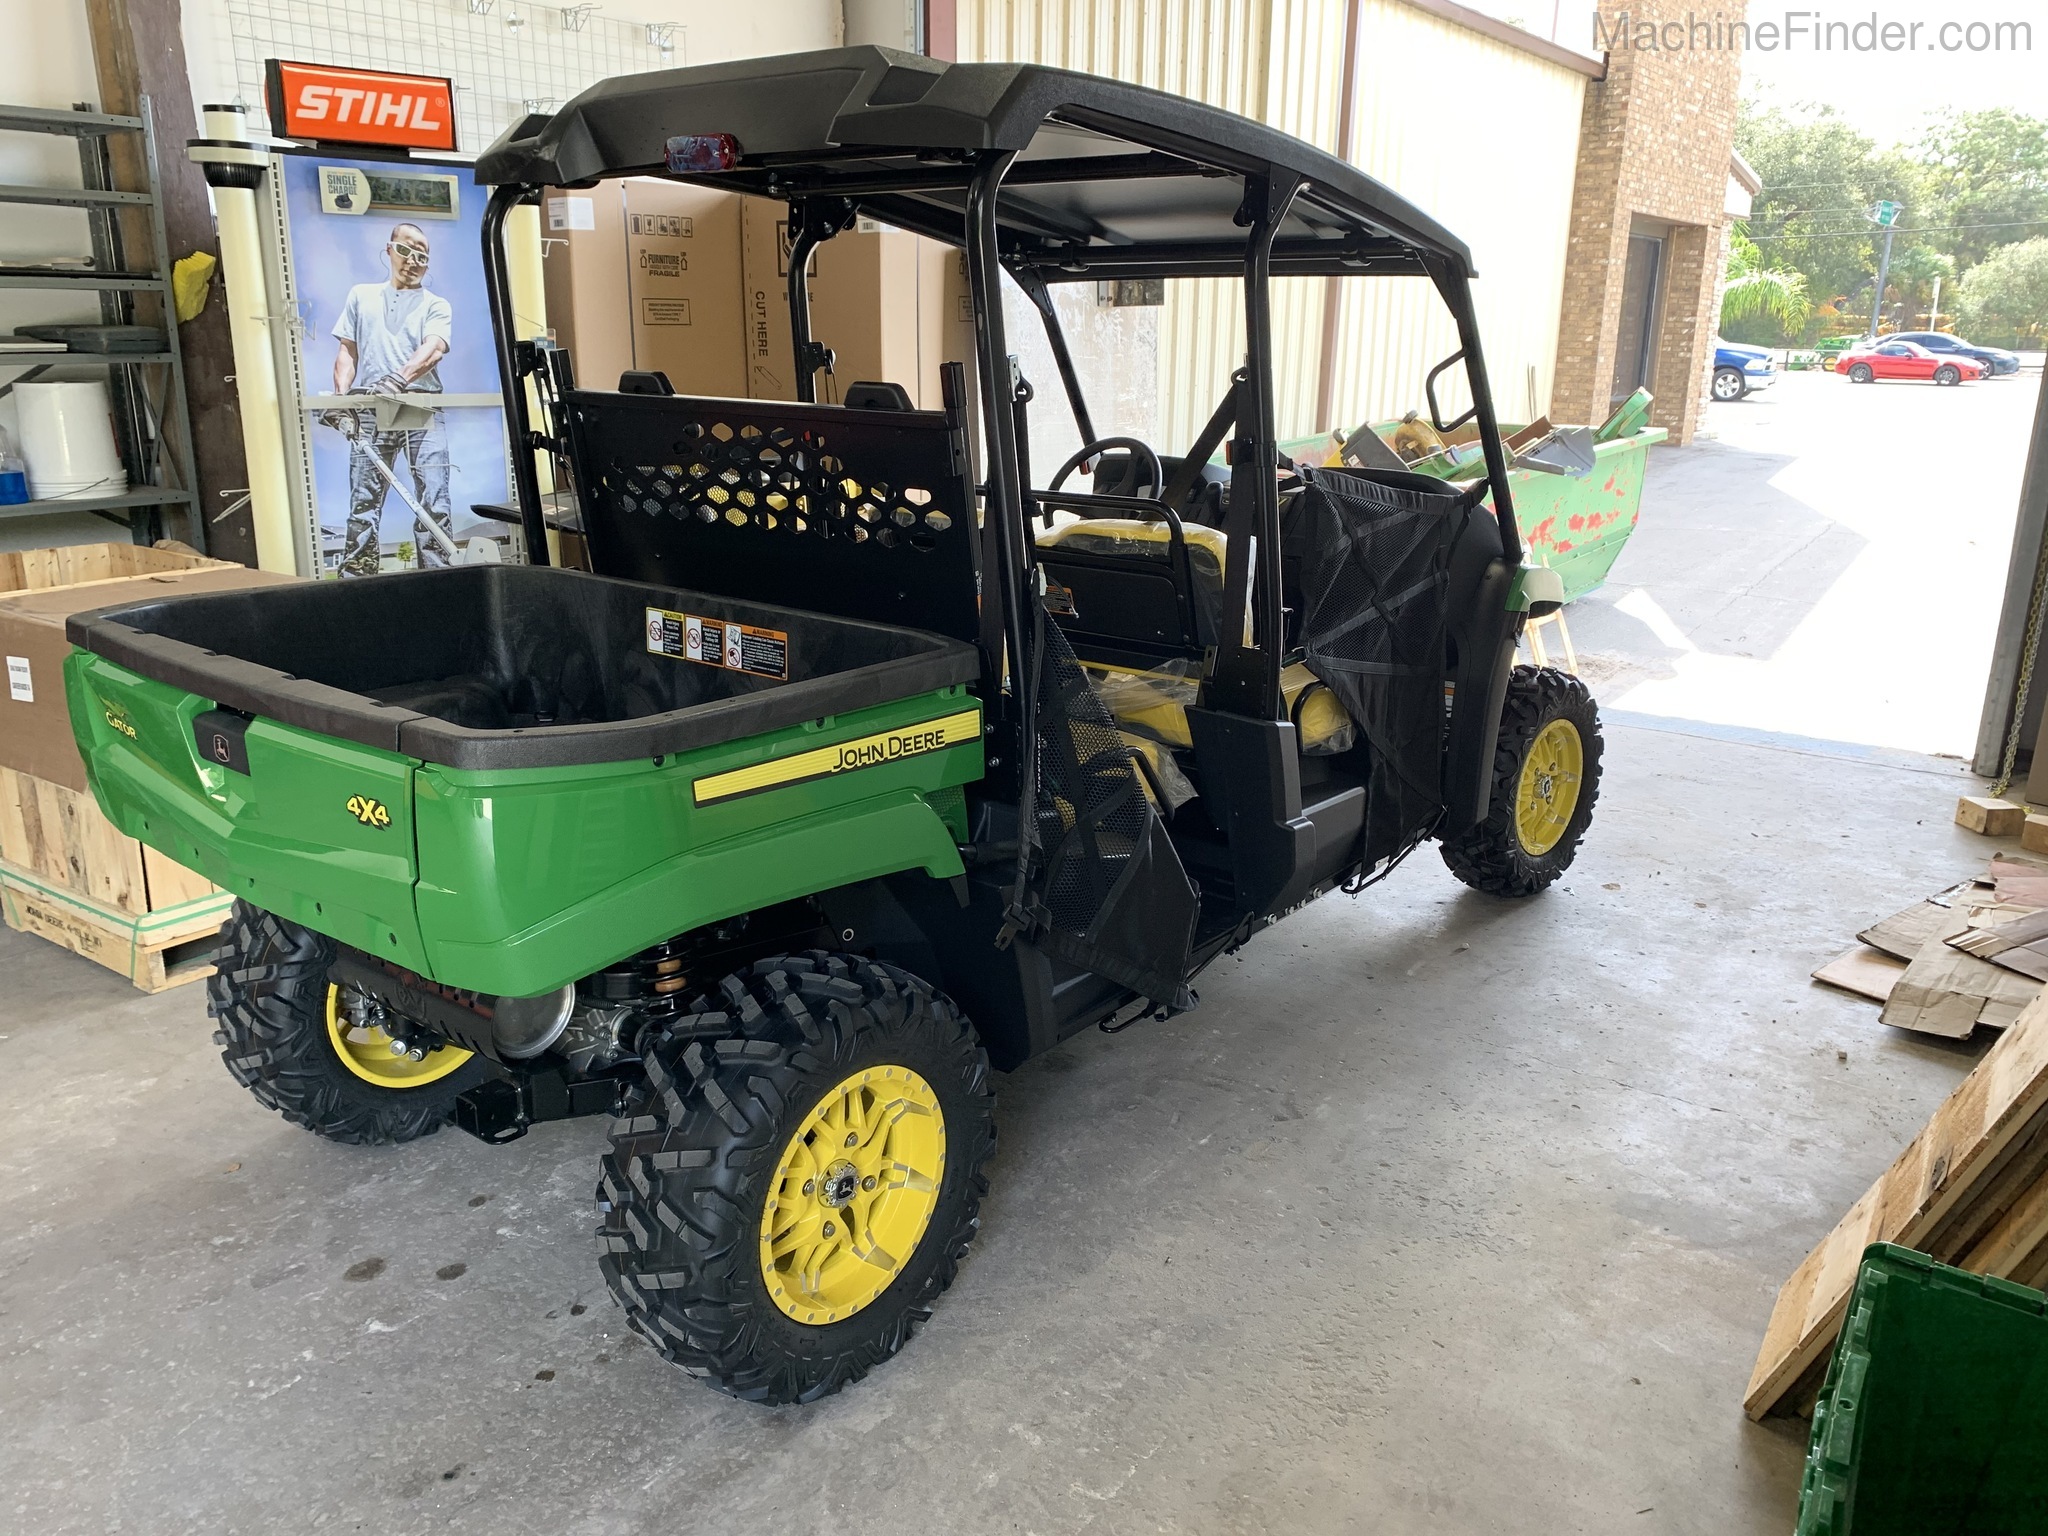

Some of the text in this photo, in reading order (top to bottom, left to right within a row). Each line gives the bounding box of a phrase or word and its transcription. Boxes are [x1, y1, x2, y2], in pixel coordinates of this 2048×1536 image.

[296, 85, 440, 131] STIHL
[327, 174, 357, 187] SINGLE
[648, 254, 680, 265] FURNITURE
[755, 291, 768, 356] CUT HERE
[105, 711, 138, 740] GATOR
[833, 729, 945, 770] JOHN DEERE
[346, 795, 391, 828] 4X4
